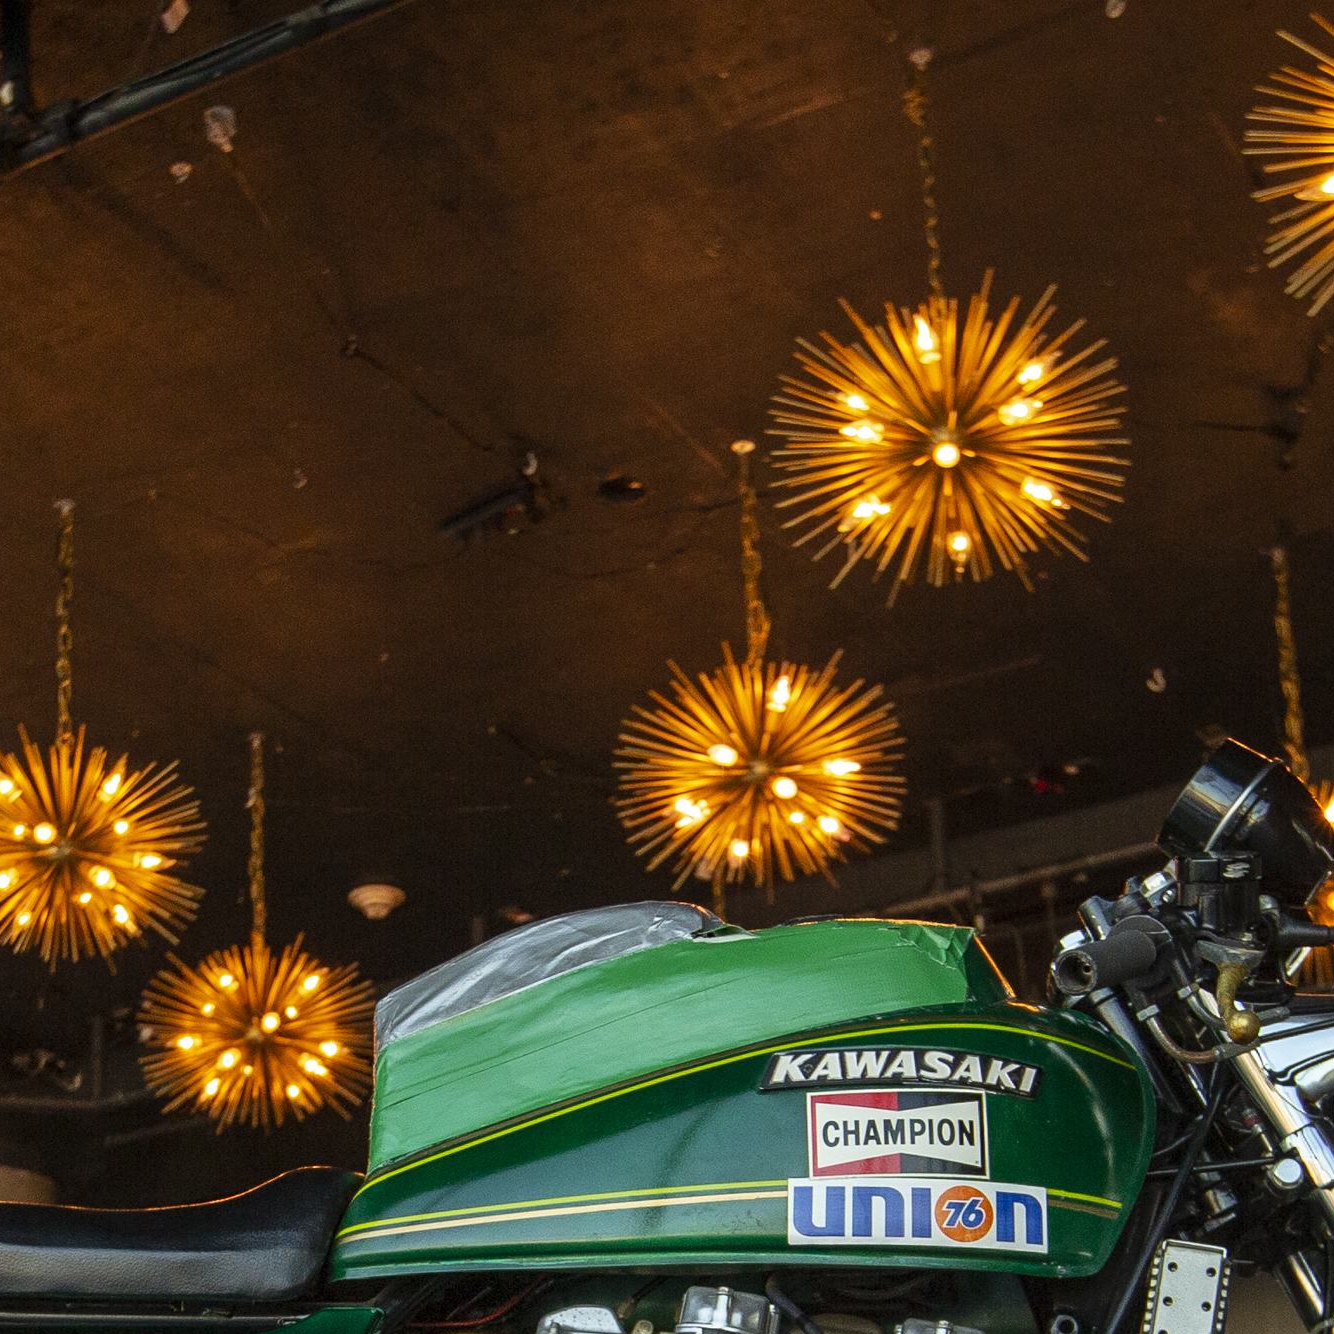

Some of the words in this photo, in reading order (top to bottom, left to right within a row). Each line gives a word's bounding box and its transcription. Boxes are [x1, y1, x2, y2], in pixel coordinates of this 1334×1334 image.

[769, 1050, 1038, 1094] KAWASAKI
[821, 1118, 976, 1148] CHAMPION
[941, 1196, 987, 1230] 76
